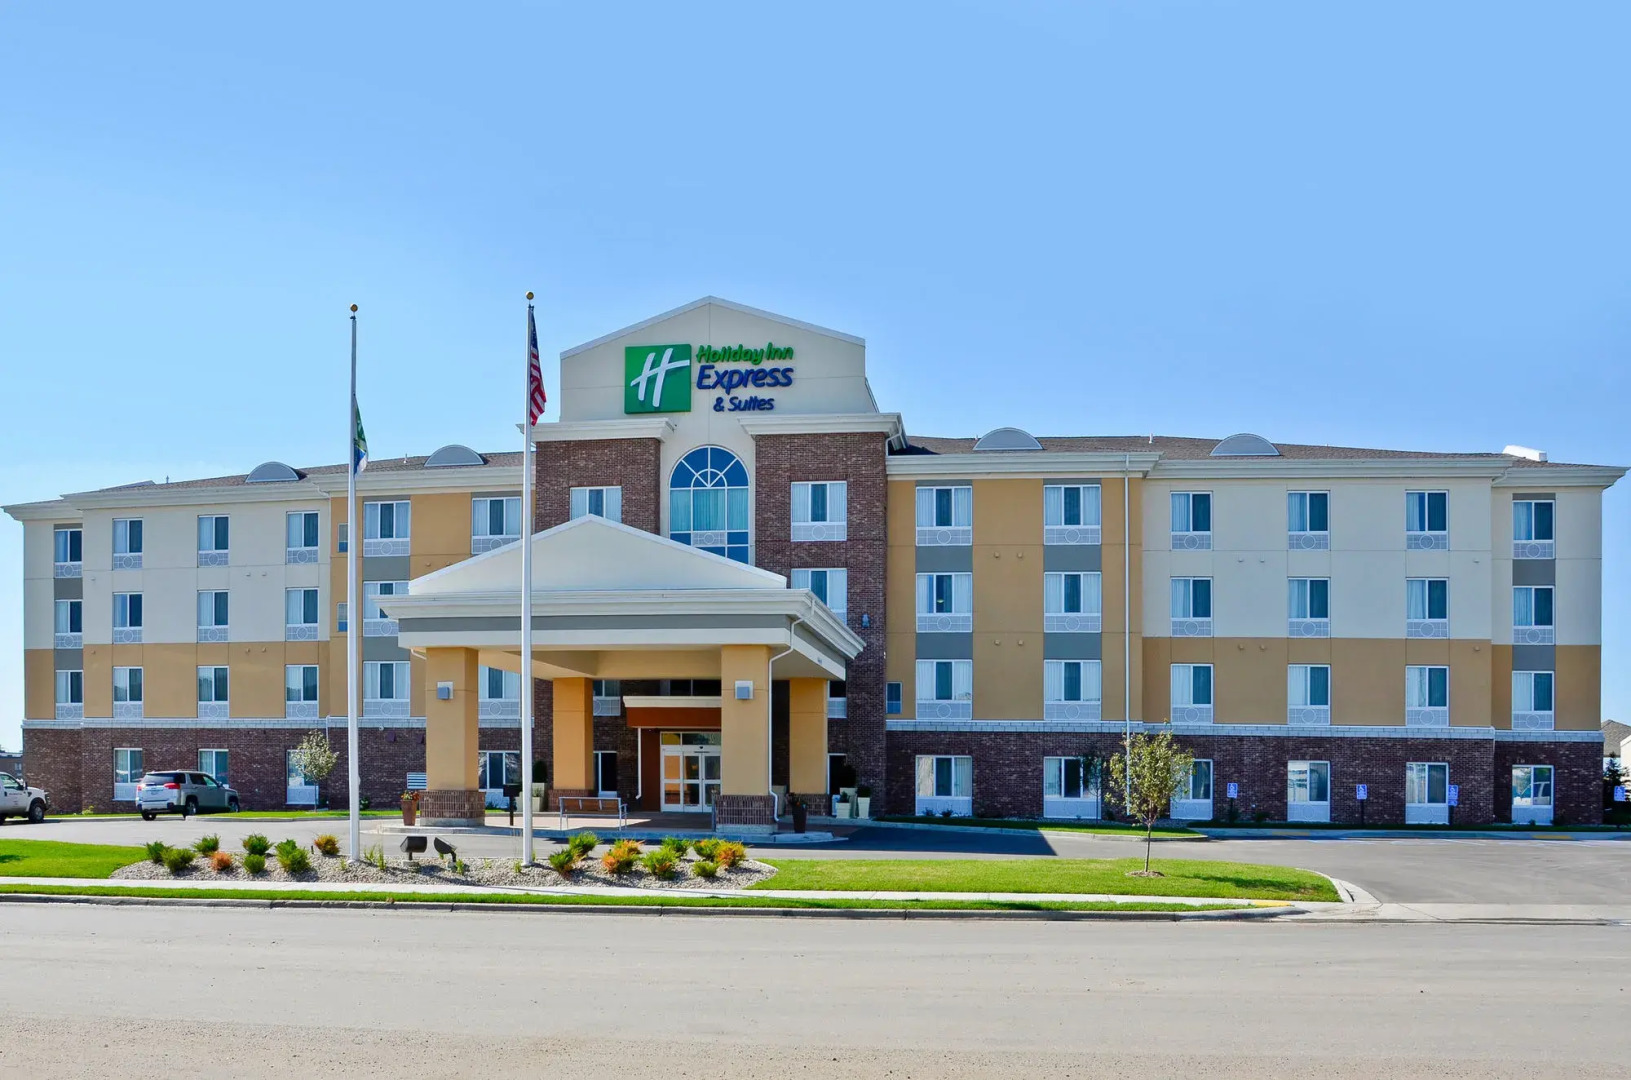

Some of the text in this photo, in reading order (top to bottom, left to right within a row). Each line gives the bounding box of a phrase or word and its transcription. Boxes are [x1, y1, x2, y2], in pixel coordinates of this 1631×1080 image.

[696, 342, 794, 365] Holiday Inn
[696, 364, 794, 395] Express
[713, 396, 775, 412] & Suites
